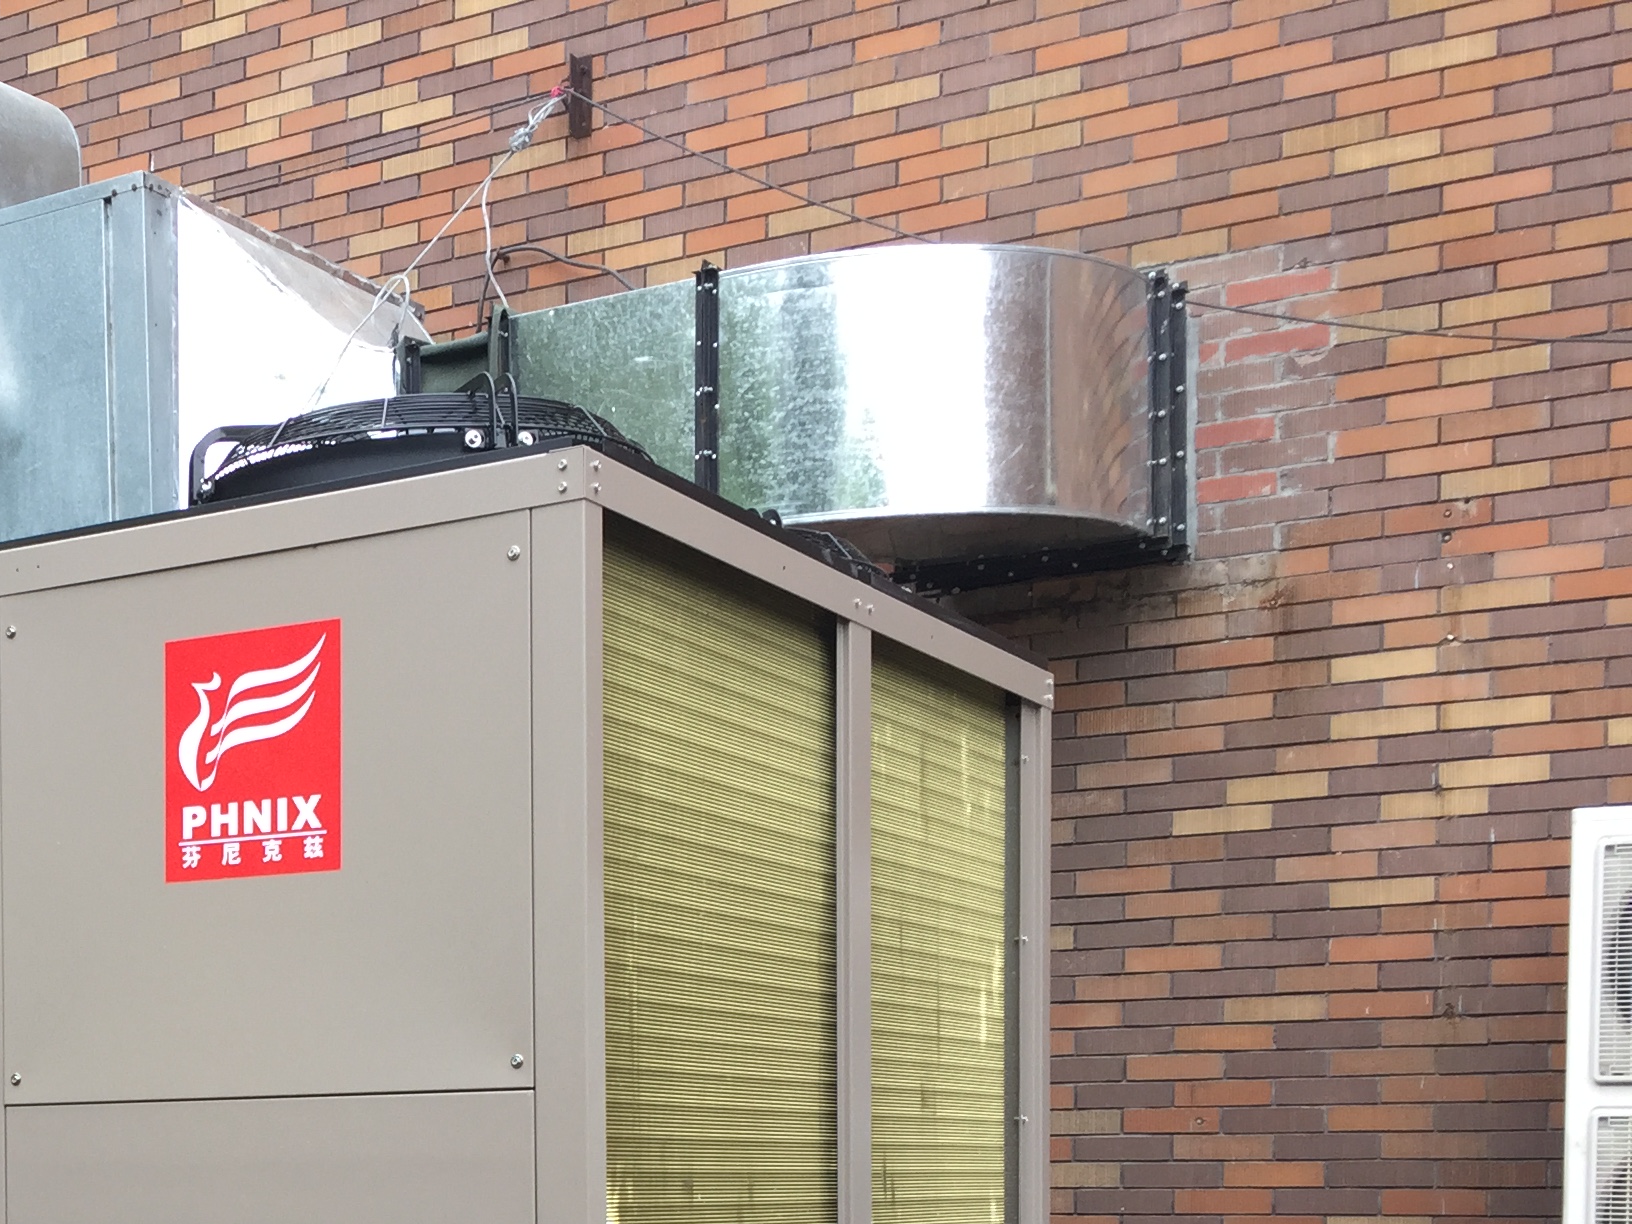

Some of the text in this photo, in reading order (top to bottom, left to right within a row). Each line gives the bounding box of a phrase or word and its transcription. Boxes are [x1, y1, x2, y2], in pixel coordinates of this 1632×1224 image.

[182, 794, 322, 840] PHNIX
[181, 835, 324, 869] 芬尼克兹
